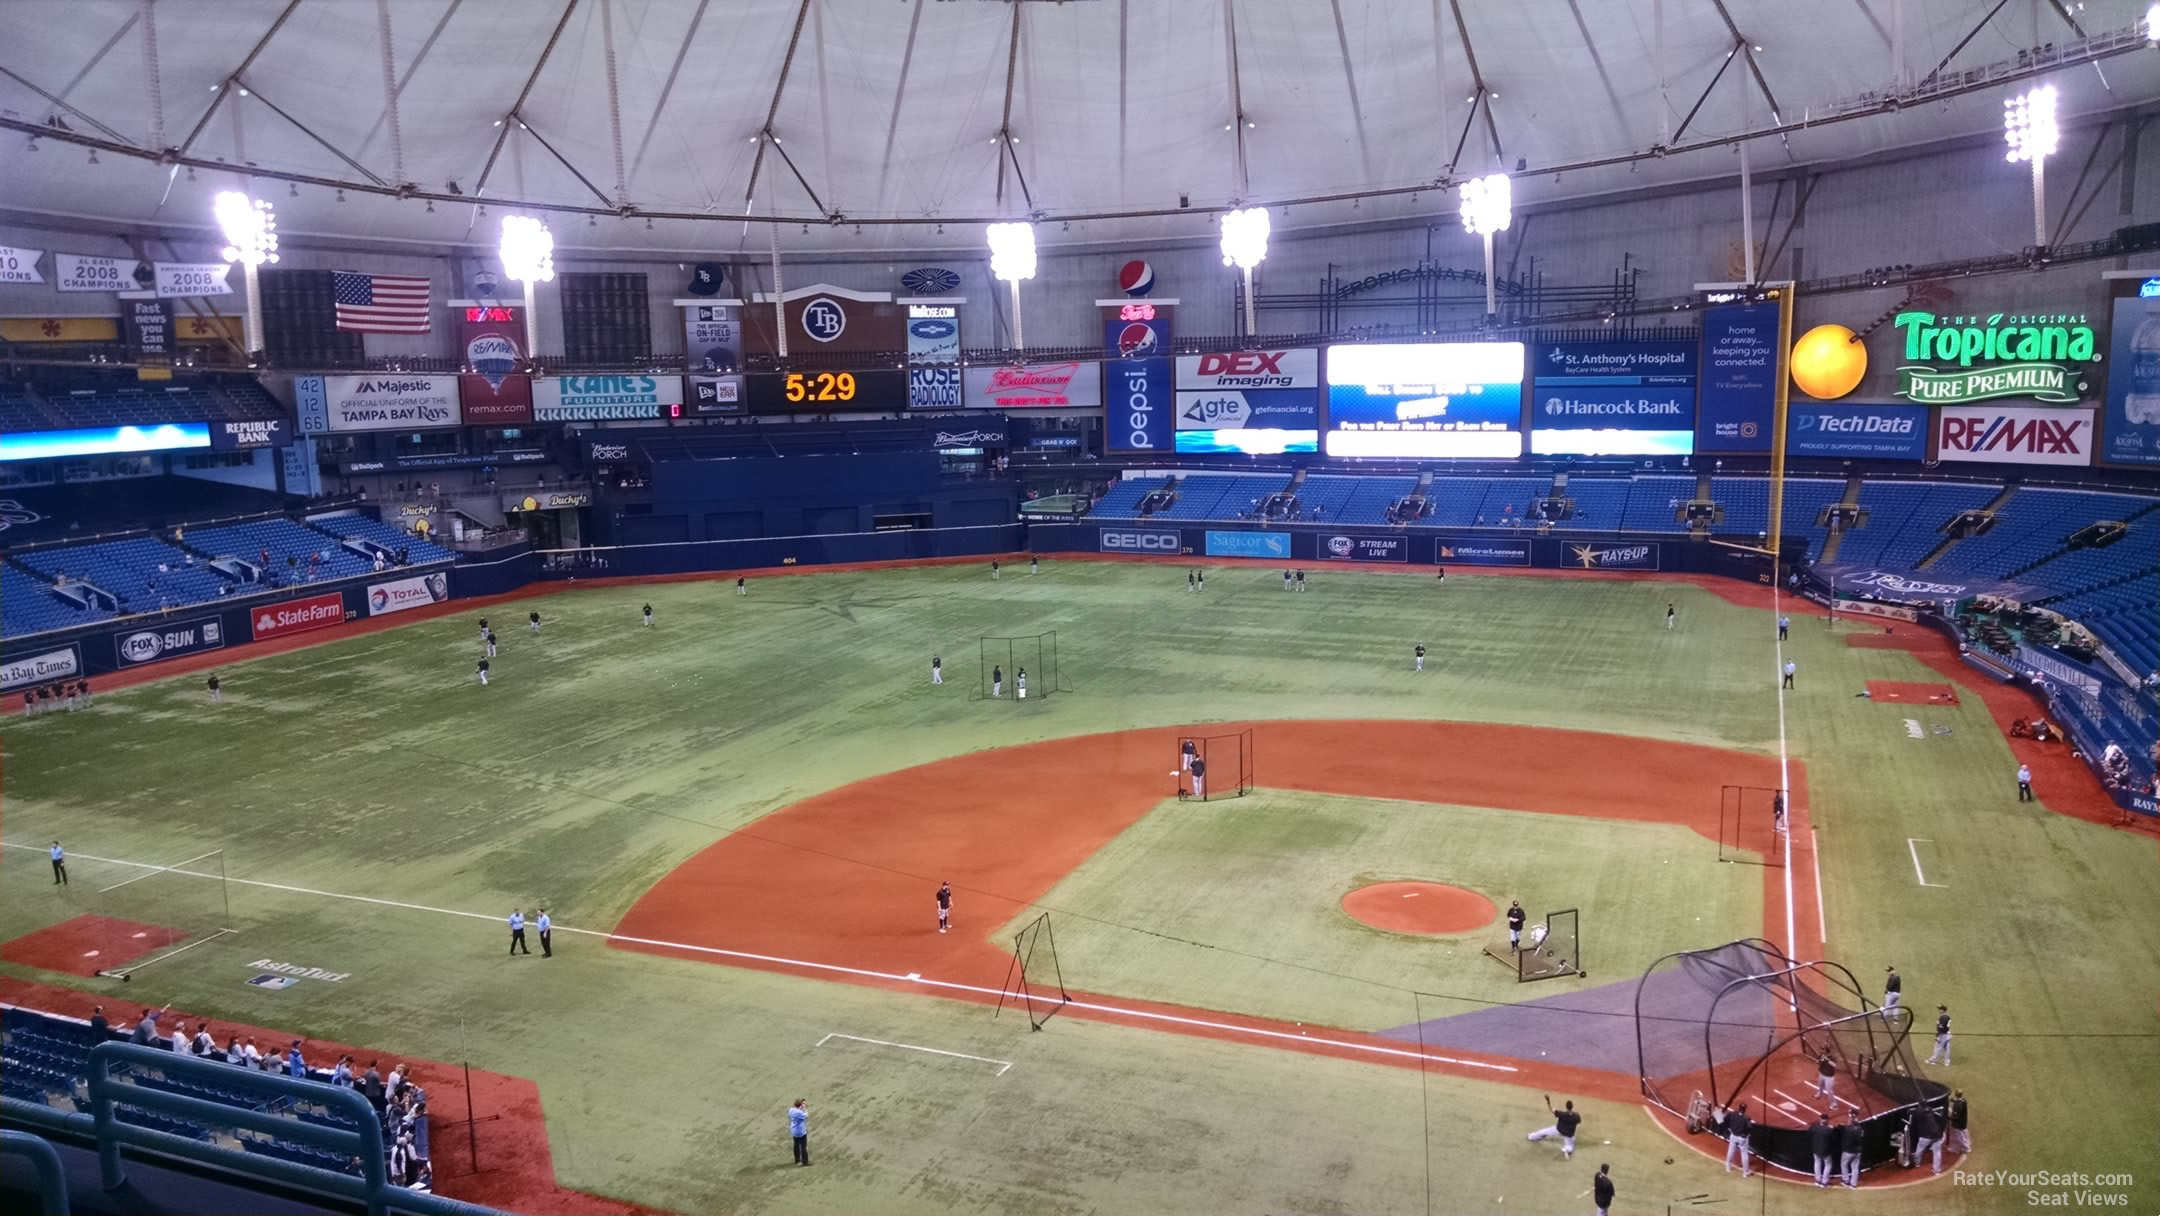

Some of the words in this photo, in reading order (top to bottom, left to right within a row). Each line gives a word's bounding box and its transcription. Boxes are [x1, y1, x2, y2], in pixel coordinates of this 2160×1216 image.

[92, 258, 115, 267] EAST
[76, 266, 118, 280] 2008
[173, 272, 213, 285] 2008
[64, 279, 131, 290] CHAMPIONS
[161, 285, 224, 294] CHAMPIONS
[135, 302, 161, 314] Fast
[135, 315, 167, 324] news
[810, 306, 840, 334] TB
[1941, 316, 1977, 325] THE
[2009, 315, 2088, 325] ORIGINAL
[140, 325, 163, 336] you
[696, 329, 731, 338] ON-FIELD
[1728, 325, 1756, 334] home
[142, 335, 164, 344] can
[1894, 311, 2094, 367] Tropicana
[1713, 346, 1750, 357] keeping
[1752, 347, 1770, 357] you
[1197, 352, 1287, 376] DEX
[1565, 354, 1580, 364] St.
[1582, 353, 1636, 366] Anthony's
[1638, 352, 1685, 365] Hospital
[1715, 356, 1767, 366] connected.
[1565, 366, 1589, 374] BayCare
[1611, 366, 1632, 374] System
[910, 368, 961, 387] ROSE
[1216, 374, 1294, 387] imaging
[1910, 377, 1962, 398] PURE
[1966, 369, 2063, 396] PREMIUM
[301, 379, 320, 393] 42
[377, 380, 432, 396] Majestic
[786, 372, 856, 402] 5:29
[564, 395, 652, 405] FURNITURE
[911, 386, 961, 407] RADIOLOGY
[304, 397, 319, 411] 12
[341, 399, 378, 409] OFFICIAL
[380, 398, 418, 408] UNIFORM
[432, 397, 448, 405] THE
[469, 404, 526, 414] remax.com
[1205, 397, 1240, 418] gte
[1564, 399, 1635, 414] Hancock
[1638, 399, 1682, 414] Bank
[341, 410, 388, 422] TAMPA
[391, 409, 415, 420] BAY
[1124, 371, 1154, 449] pepsi
[1255, 405, 1314, 415] gtefinancial.org
[225, 420, 280, 434] REPUBLIC
[304, 416, 323, 430] 66
[1715, 423, 1739, 431] bright
[237, 431, 270, 443] BANK
[974, 432, 1004, 441] PORCH
[1941, 416, 2083, 454] RE/MAX
[1800, 442, 1829, 450] PROUDLY
[1830, 443, 1873, 451] SUPPORTING
[592, 450, 628, 460] PORCH
[1103, 533, 1179, 550] GEICO
[1213, 533, 1261, 550] Sagicor
[1359, 541, 1398, 550] STREAM
[1182, 546, 1194, 554] 370
[1368, 549, 1388, 557] LIVE
[1457, 547, 1525, 556] MicroLumen
[392, 588, 427, 600] TOTAL
[345, 610, 357, 620] 370
[130, 636, 156, 652] FOX
[165, 629, 195, 650] SUN
[11, 666, 36, 681] Bay
[36, 659, 72, 676] Times
[246, 959, 353, 983] AstroTurf
